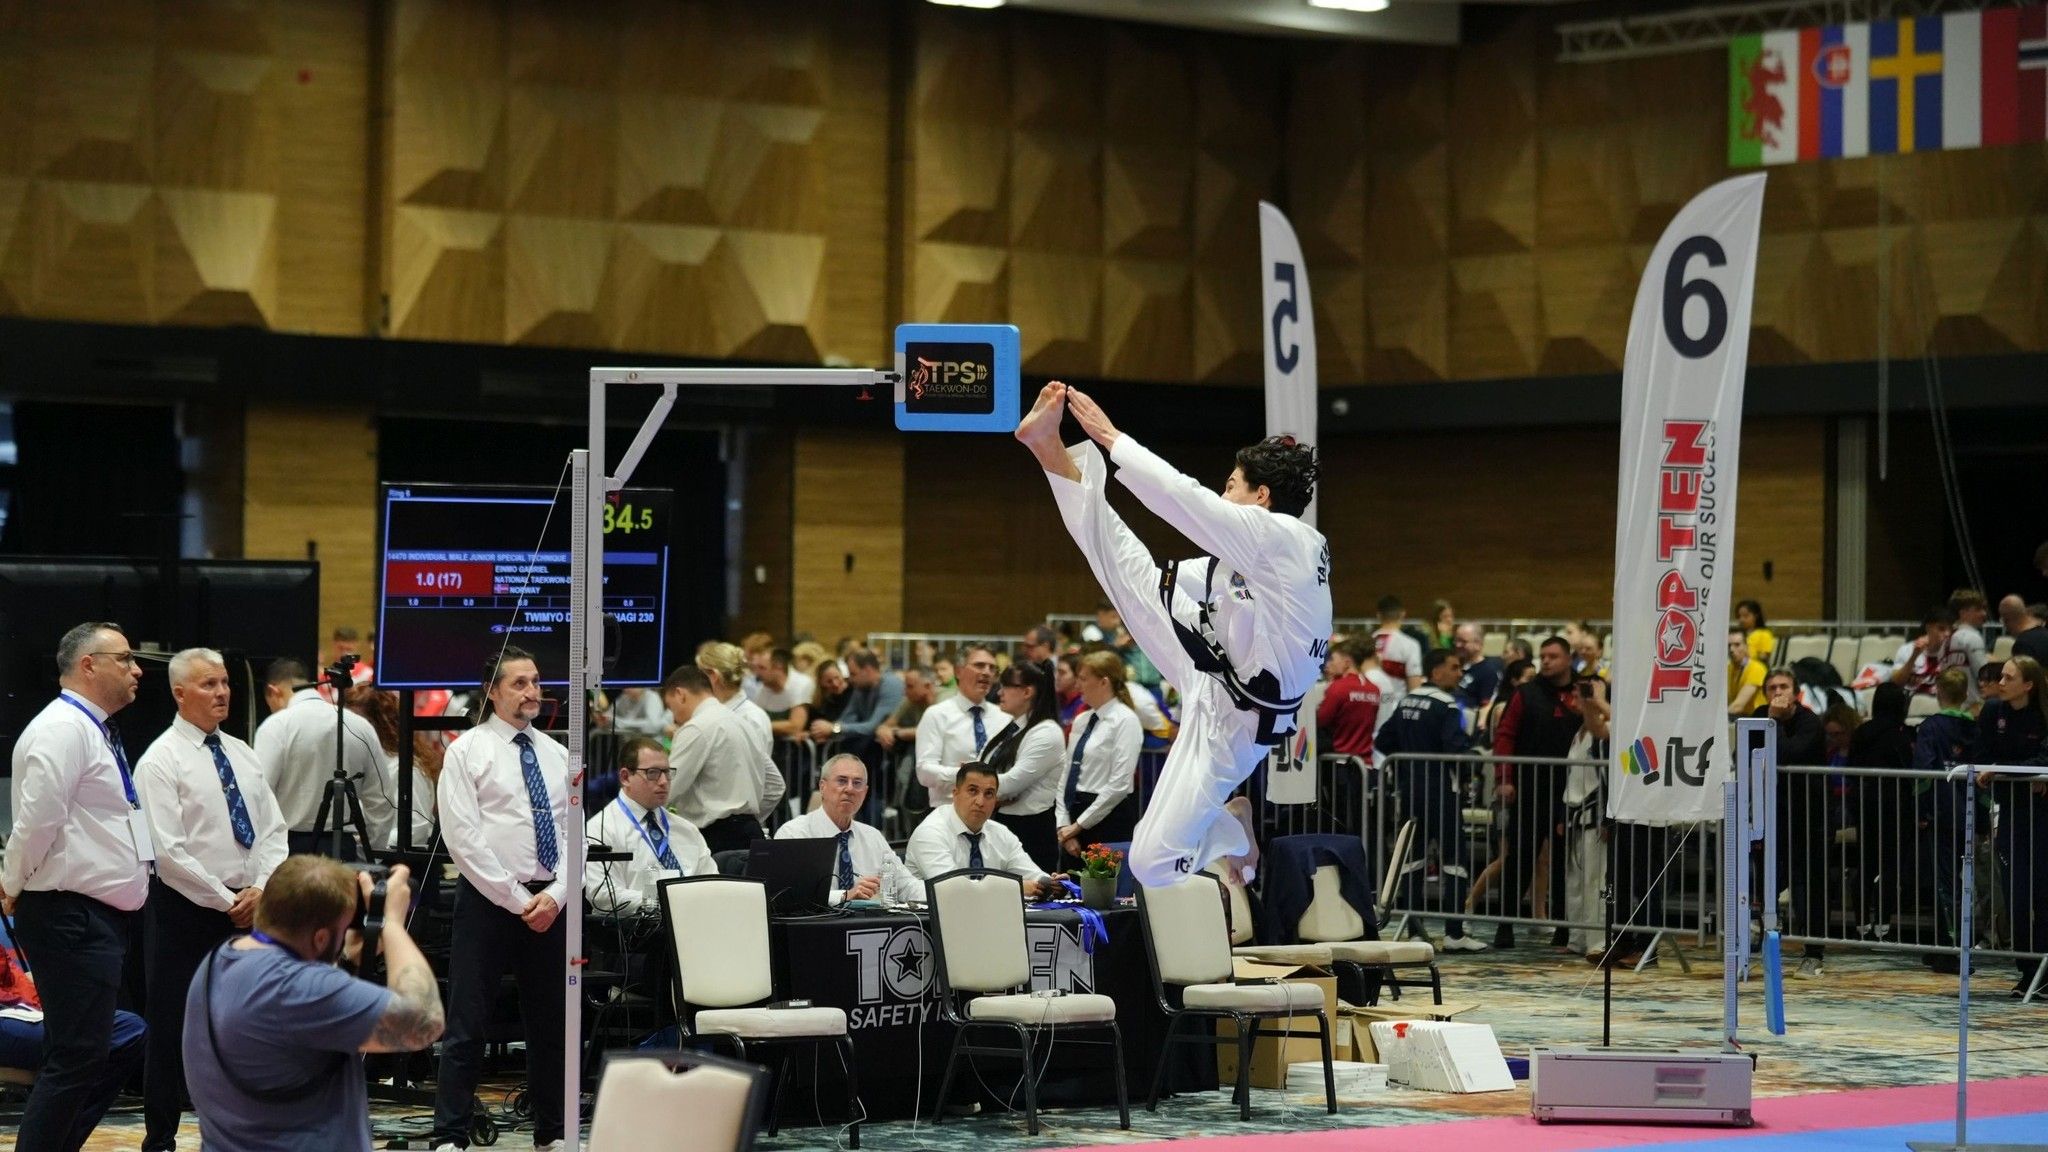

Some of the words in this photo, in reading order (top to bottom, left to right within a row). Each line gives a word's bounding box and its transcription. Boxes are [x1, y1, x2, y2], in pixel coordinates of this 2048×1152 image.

[1662, 234, 1728, 360] 6
[926, 361, 976, 384] TPS
[924, 384, 988, 394] TAEKWON-DO
[1656, 419, 1710, 563] TEN
[602, 503, 653, 534] 34.5
[1700, 531, 1717, 580] OUR
[415, 571, 435, 587] 1.0
[437, 571, 462, 589] (17)
[509, 586, 541, 594] NORWAY
[524, 612, 564, 622] TWIMYO
[638, 612, 655, 622] 230
[1647, 568, 1699, 703] TOP
[846, 925, 950, 1005] TO
[568, 975, 577, 986] B
[849, 1001, 934, 1030] SAFETY
